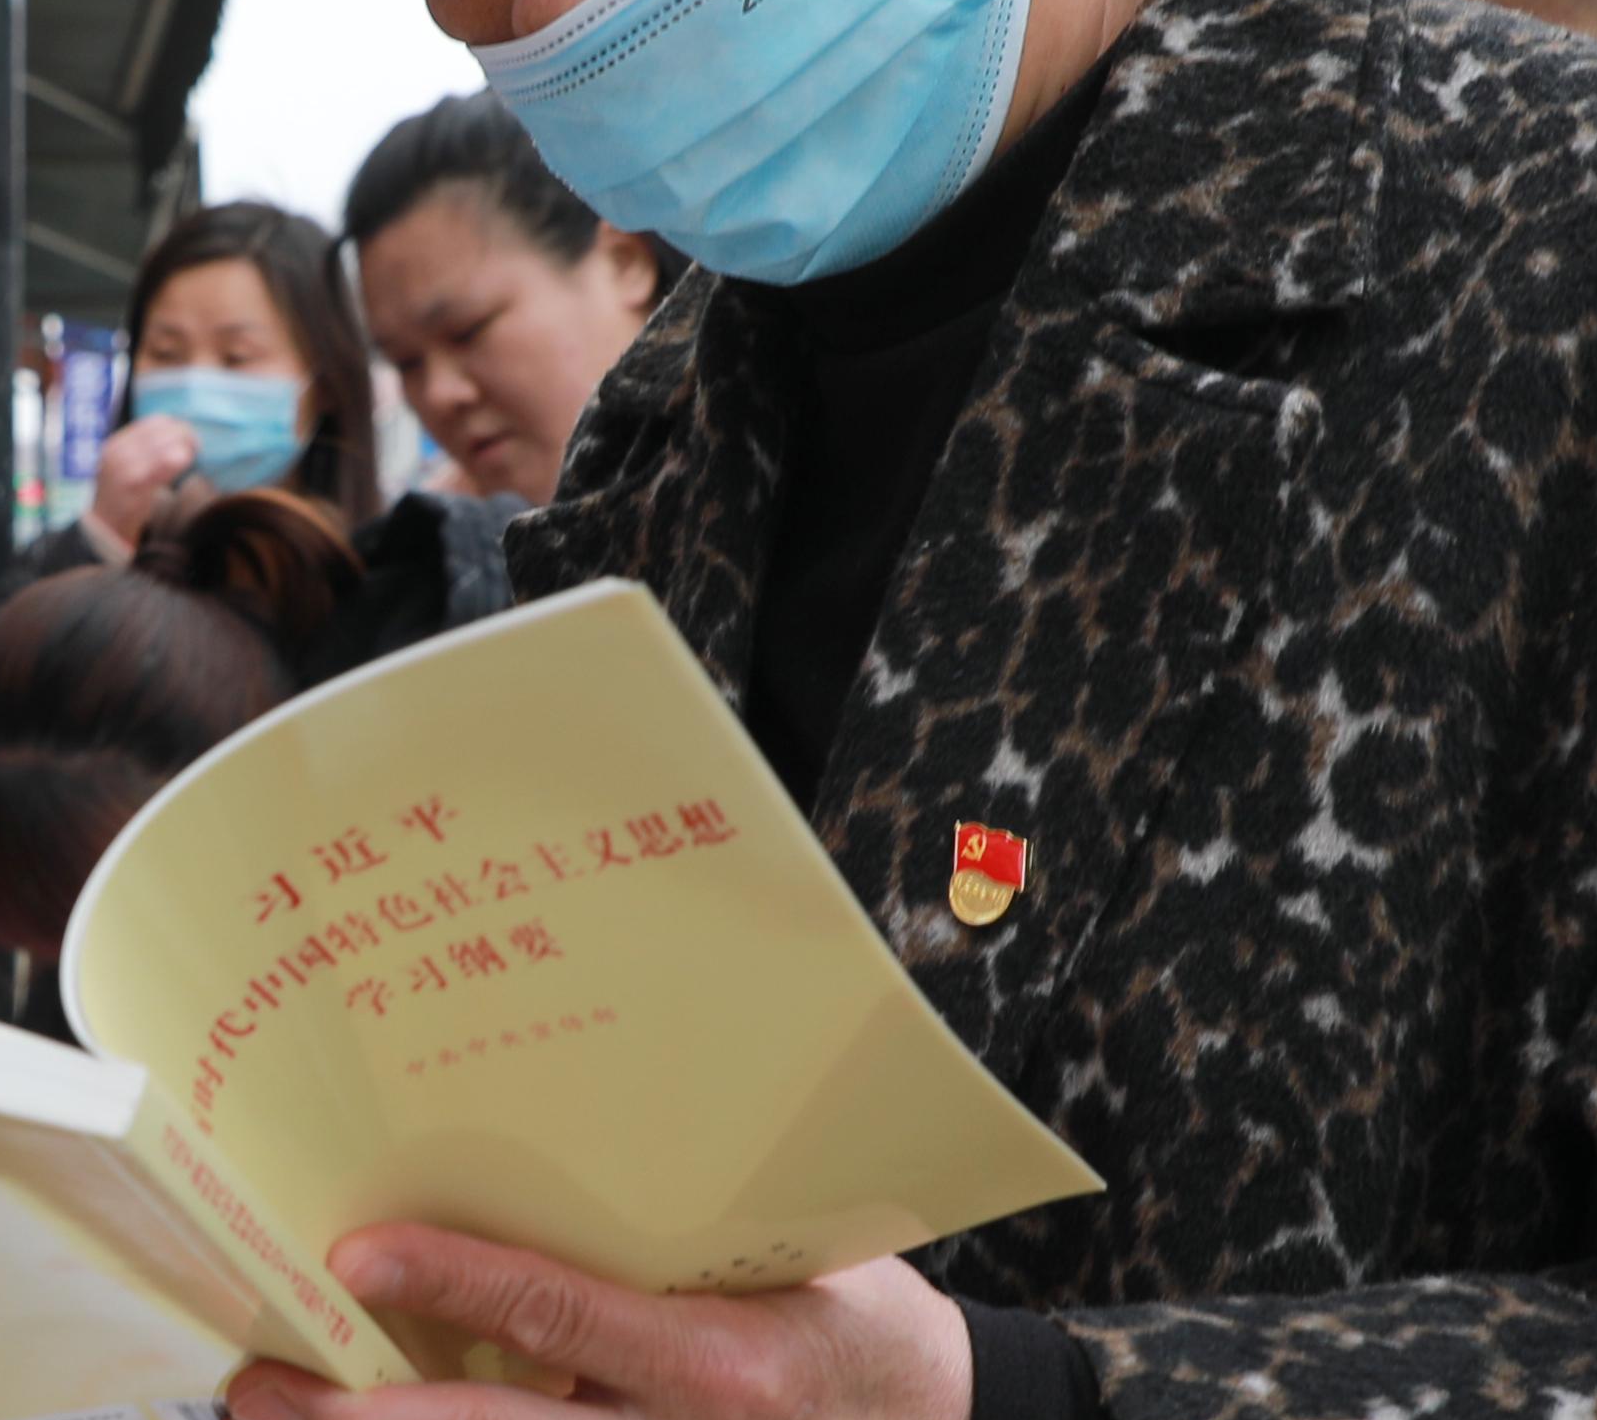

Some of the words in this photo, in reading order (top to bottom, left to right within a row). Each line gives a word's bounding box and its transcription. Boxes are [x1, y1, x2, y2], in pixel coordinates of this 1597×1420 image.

[242, 792, 460, 925] 习近平
[344, 916, 568, 1019] 学习纲要
